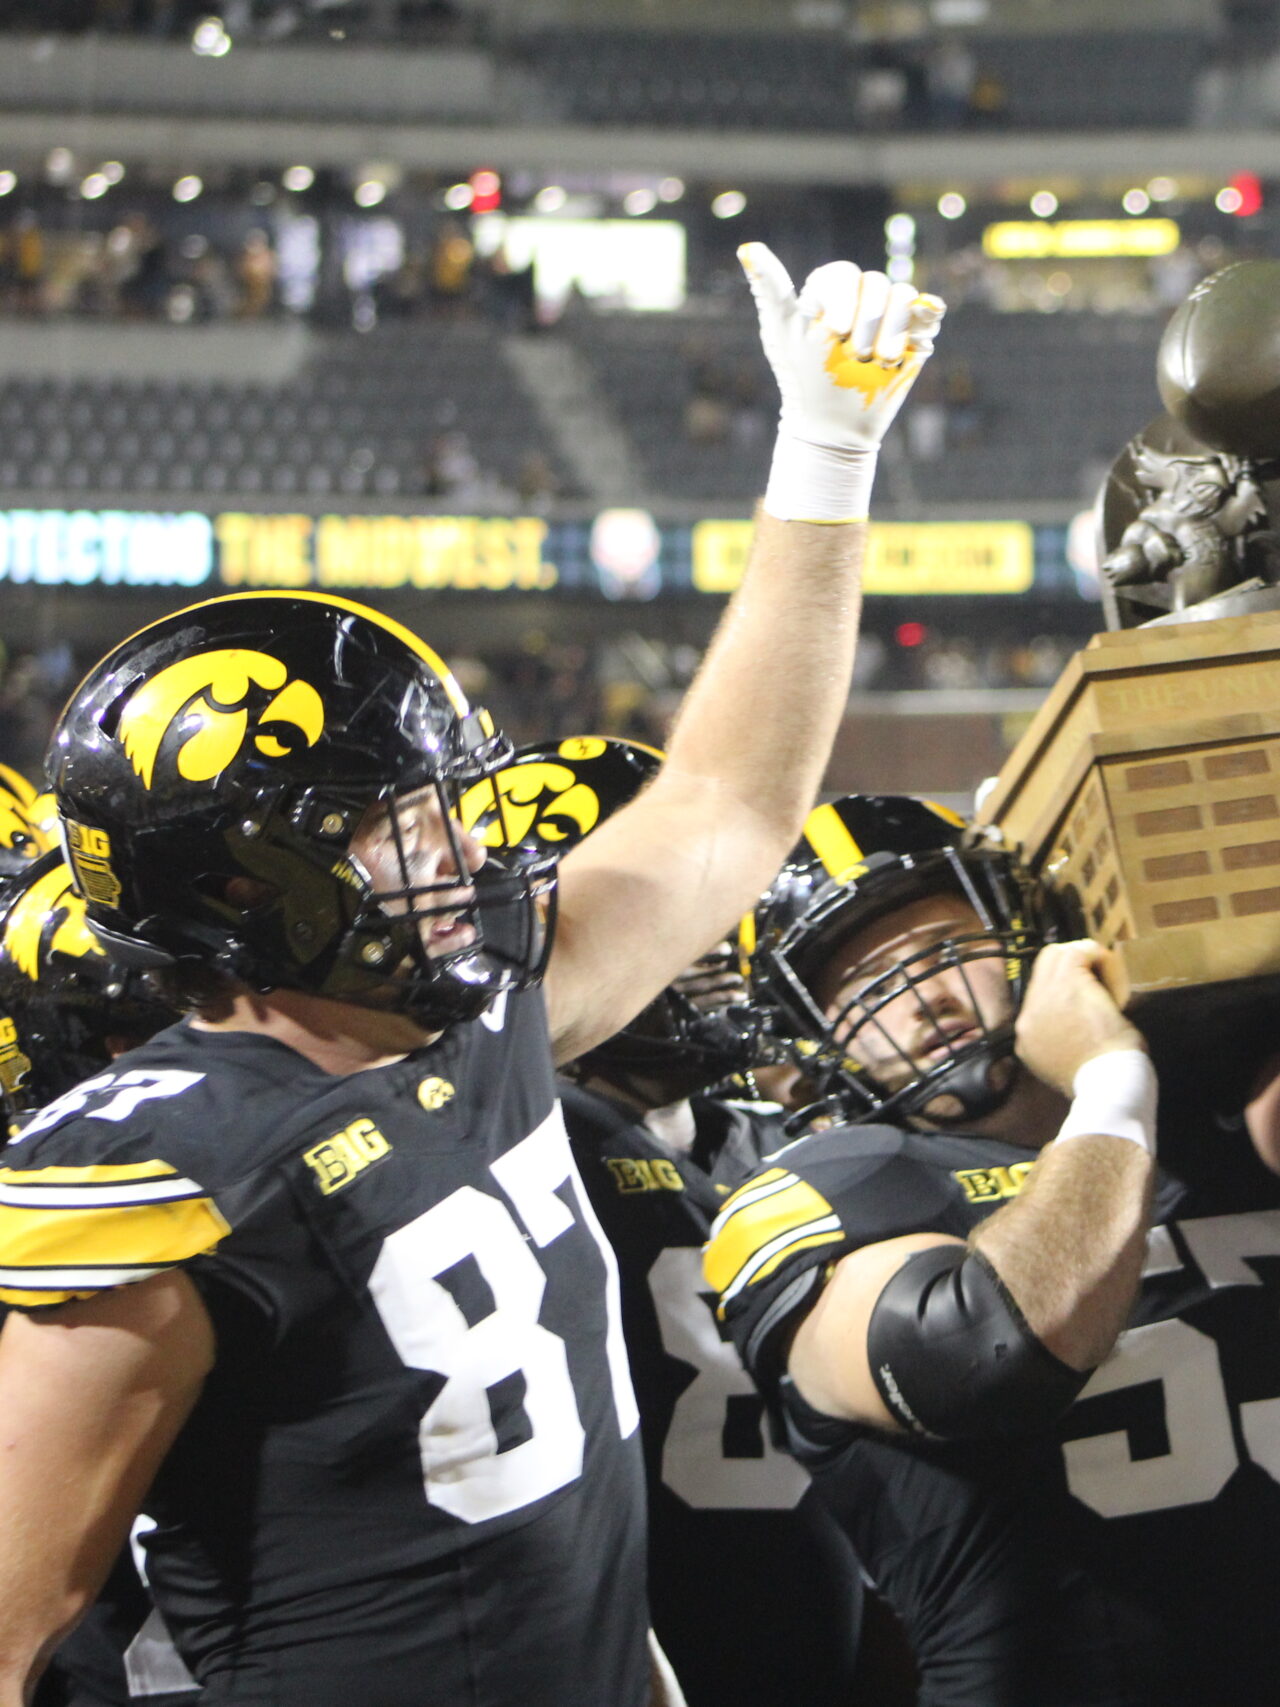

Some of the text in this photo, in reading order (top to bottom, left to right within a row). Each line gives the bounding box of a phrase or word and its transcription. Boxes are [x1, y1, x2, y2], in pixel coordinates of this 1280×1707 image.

[1111, 682, 1181, 714] THE
[302, 1117, 392, 1196] BIG
[607, 1158, 685, 1194] BIG
[368, 1098, 640, 1525] 87
